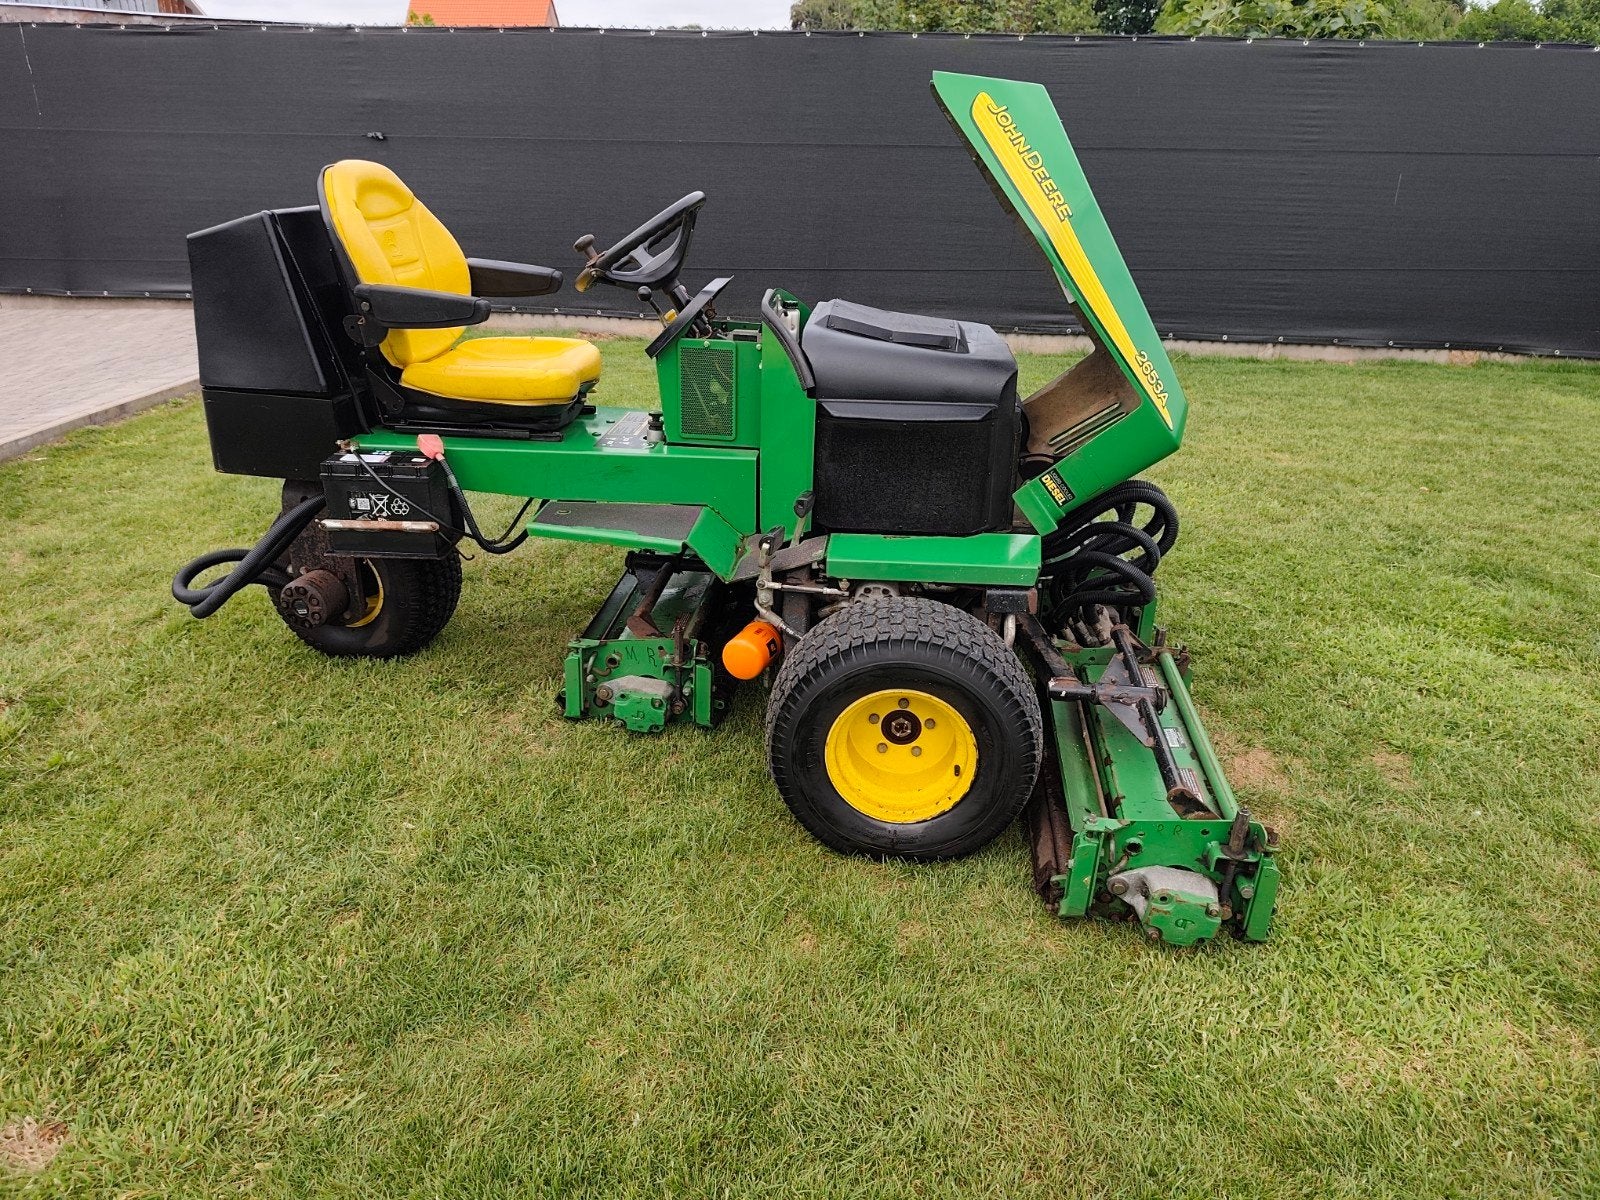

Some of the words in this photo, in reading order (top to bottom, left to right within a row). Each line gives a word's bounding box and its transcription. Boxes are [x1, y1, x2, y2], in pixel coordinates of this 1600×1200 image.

[987, 103, 1031, 155] JOHN
[1022, 150, 1073, 222] DEERE
[1135, 350, 1169, 409] 2653A
[1041, 473, 1066, 506] DIESEL
